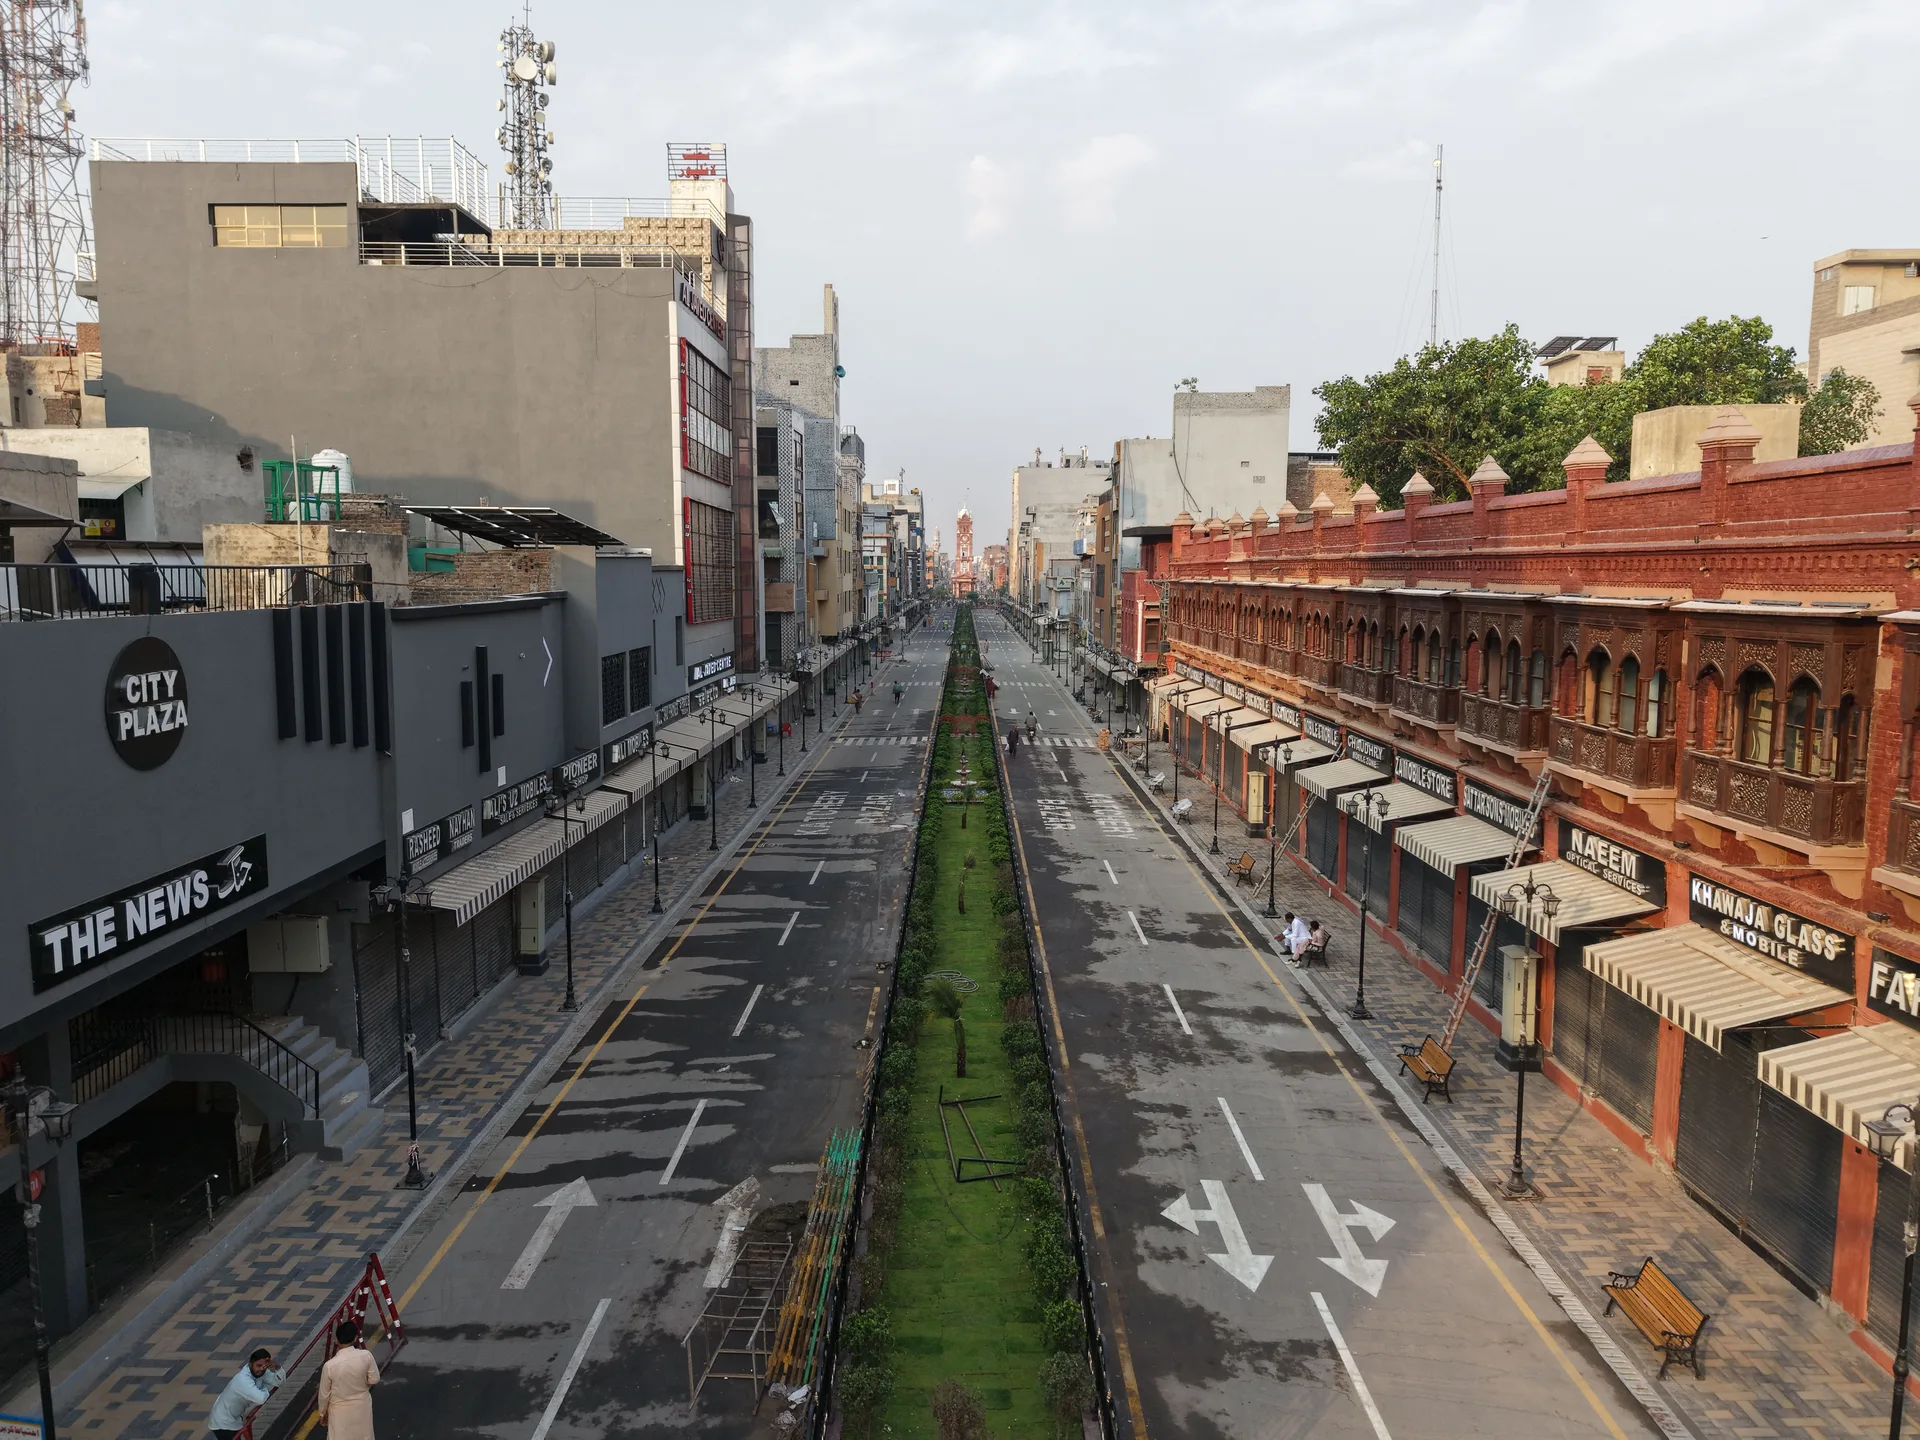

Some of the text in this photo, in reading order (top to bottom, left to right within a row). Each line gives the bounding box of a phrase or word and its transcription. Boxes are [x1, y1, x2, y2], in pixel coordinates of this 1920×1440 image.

[126, 669, 178, 704] CITY
[118, 699, 188, 741] PLAZA
[562, 752, 598, 781] PIONEER
[613, 741, 626, 762] ALI
[1347, 734, 1384, 760] CHAUDHRY
[1352, 751, 1379, 769] MOBILE ZONE
[484, 793, 507, 819] ALI'S
[520, 775, 548, 803] MOBILES
[1402, 760, 1427, 788] MOBILE
[1426, 769, 1452, 799] STORE
[794, 790, 849, 836] KATCHERY
[855, 795, 895, 824] BAZAR
[1036, 799, 1077, 830] BAZAR
[1083, 793, 1139, 840] KATCHERY
[1464, 785, 1486, 816] SATTAR
[1485, 794, 1504, 823] SONS
[408, 825, 441, 860] RASHEED
[1572, 828, 1640, 879] NAEEM
[217, 845, 253, 899] جنگ
[1566, 850, 1643, 896] OPTICAL SERVICES
[43, 869, 210, 974] THE NEWS
[1691, 878, 1840, 961] KHAWAJA GLASS
[1720, 919, 1802, 968] & MOBILE
